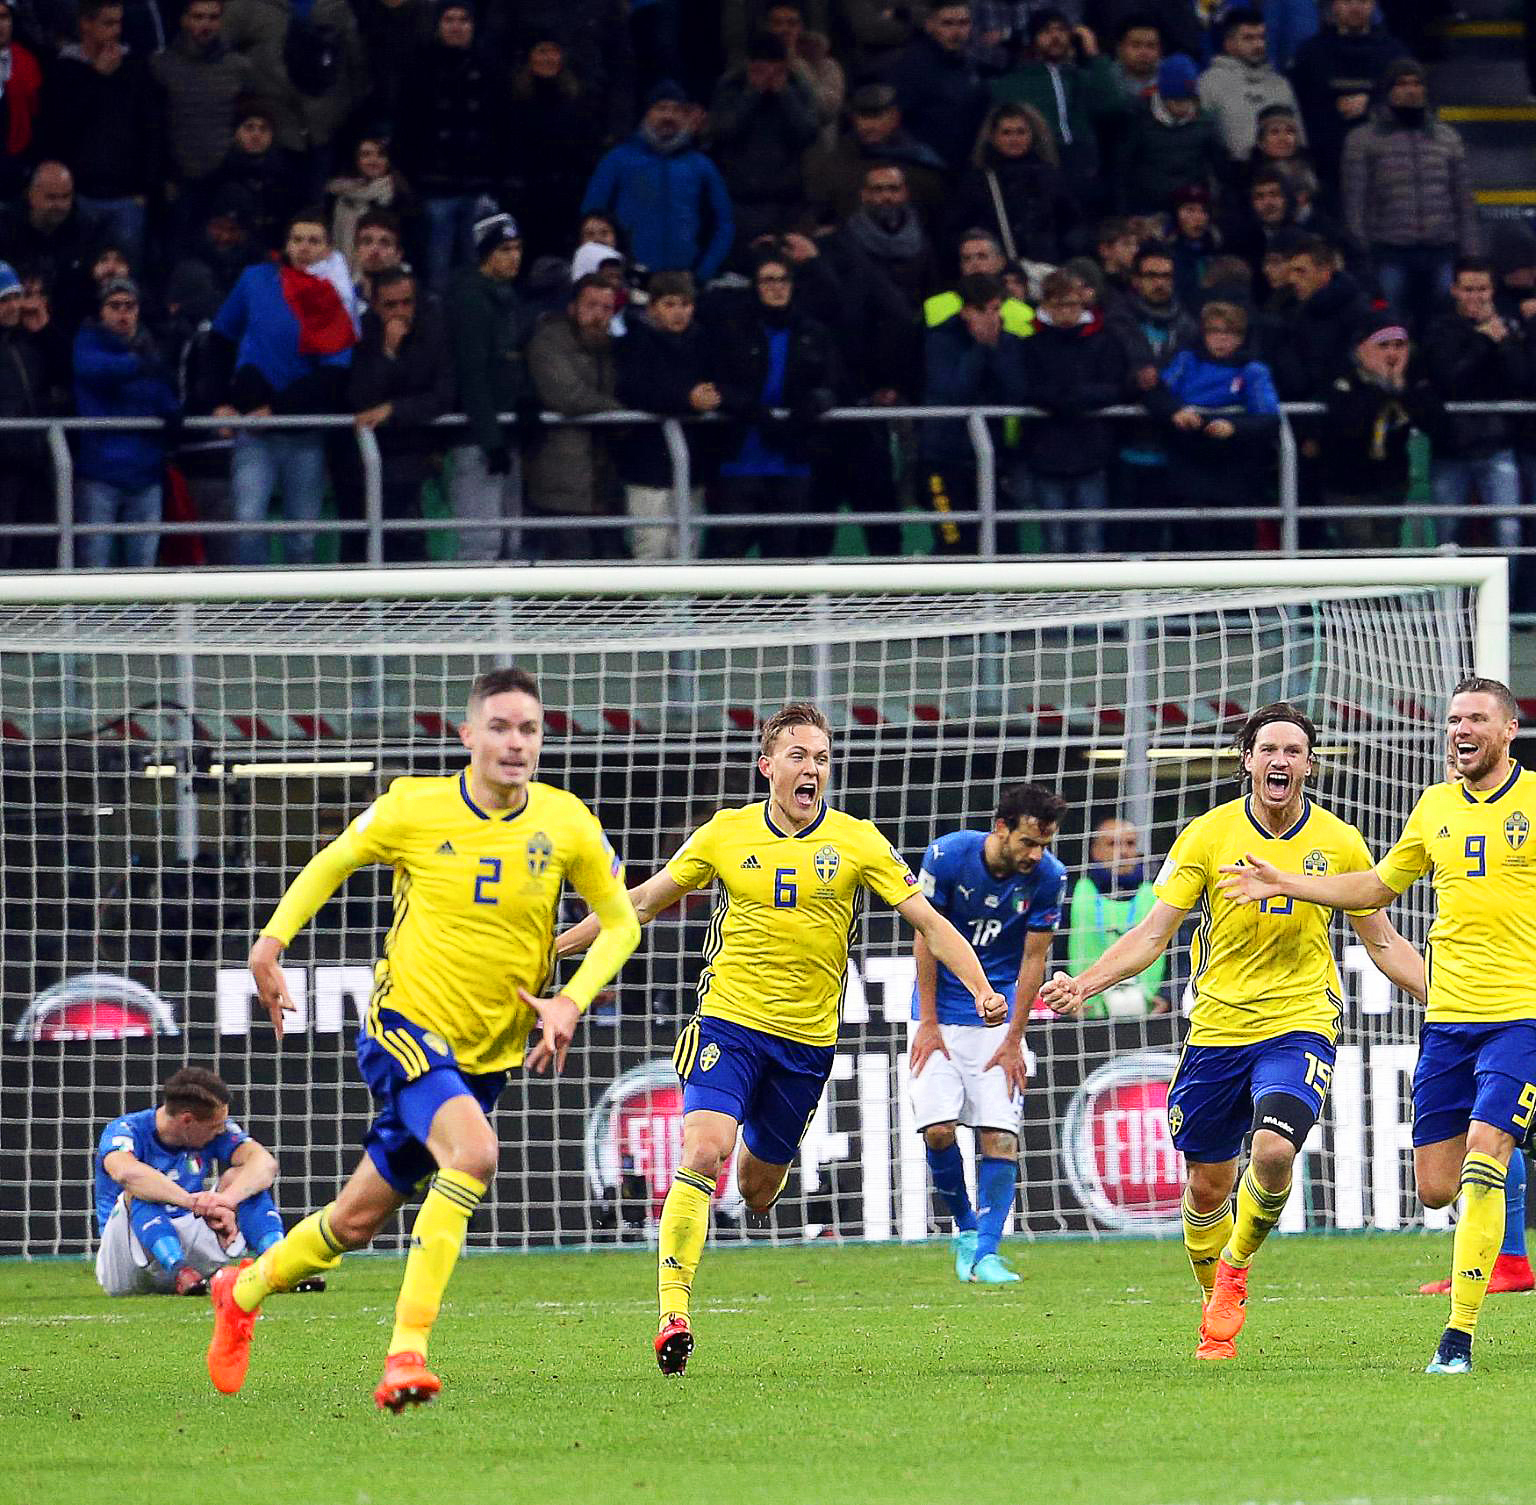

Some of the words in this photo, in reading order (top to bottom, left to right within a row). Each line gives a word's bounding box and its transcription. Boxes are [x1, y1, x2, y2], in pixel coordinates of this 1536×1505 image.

[1464, 835, 1486, 878] 9
[473, 857, 502, 905] 2
[774, 867, 798, 908] 6
[968, 918, 1003, 947] 18
